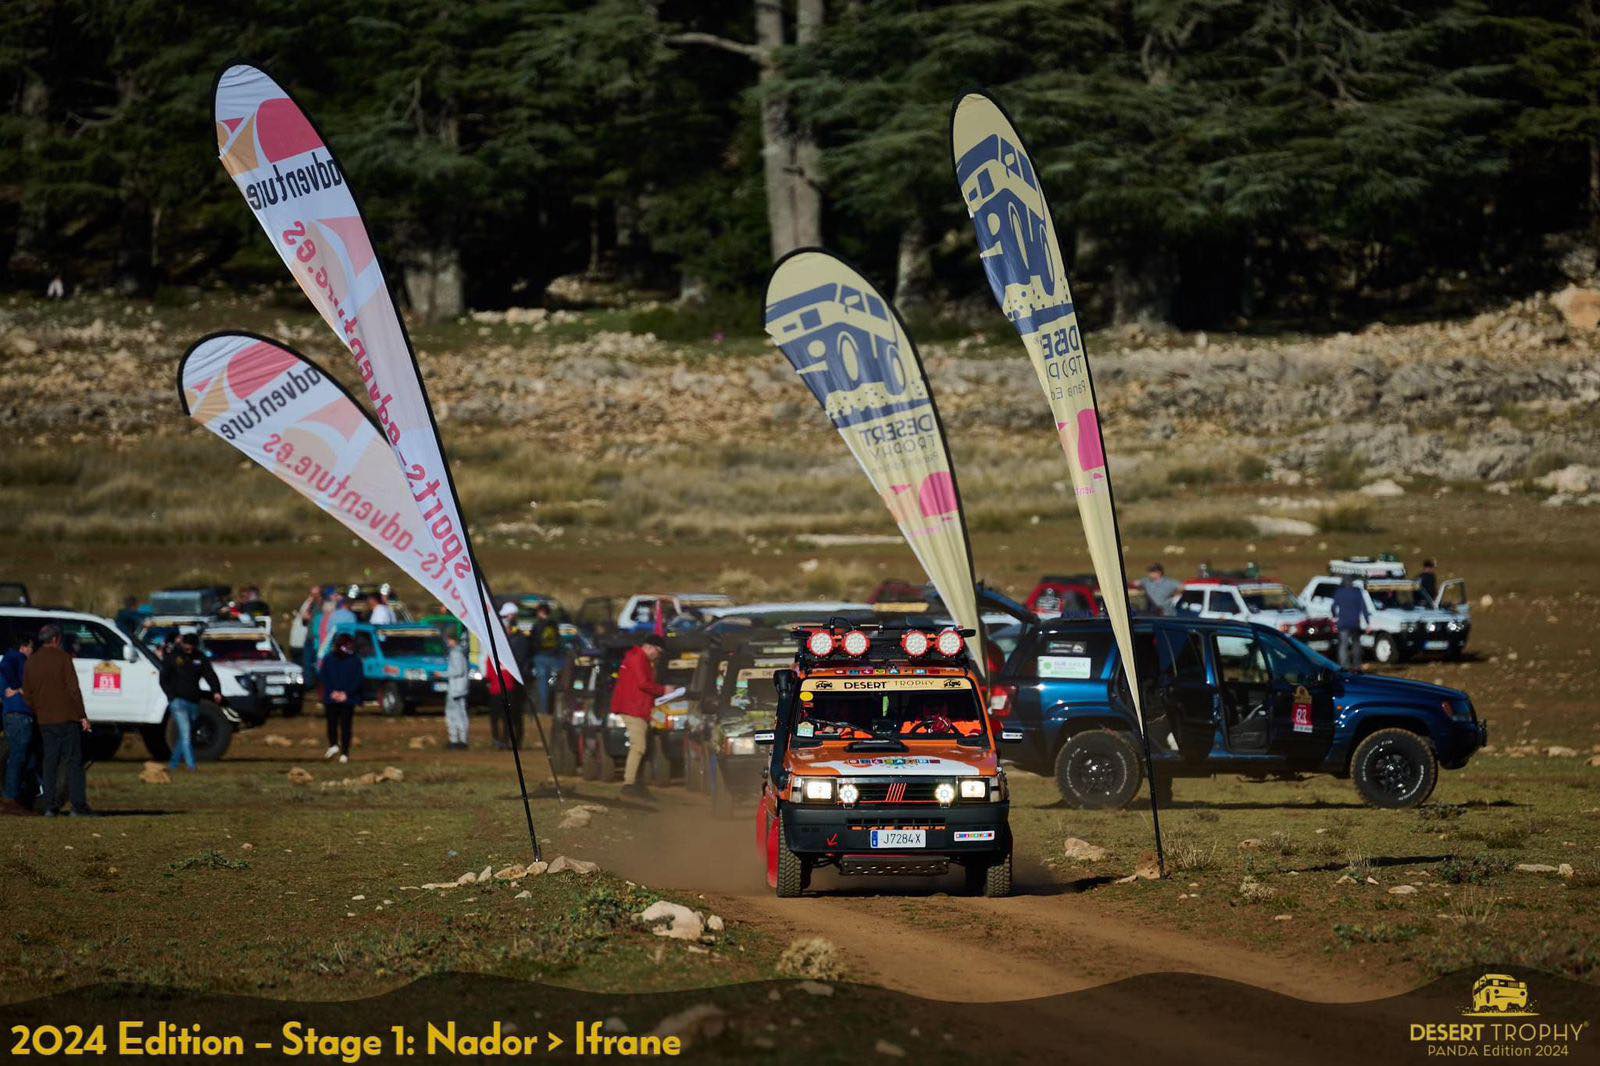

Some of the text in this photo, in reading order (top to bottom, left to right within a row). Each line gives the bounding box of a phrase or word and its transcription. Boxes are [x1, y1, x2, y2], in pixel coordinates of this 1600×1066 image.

[843, 679, 934, 690] DESERT TROPHY
[883, 833, 921, 845] J7284X
